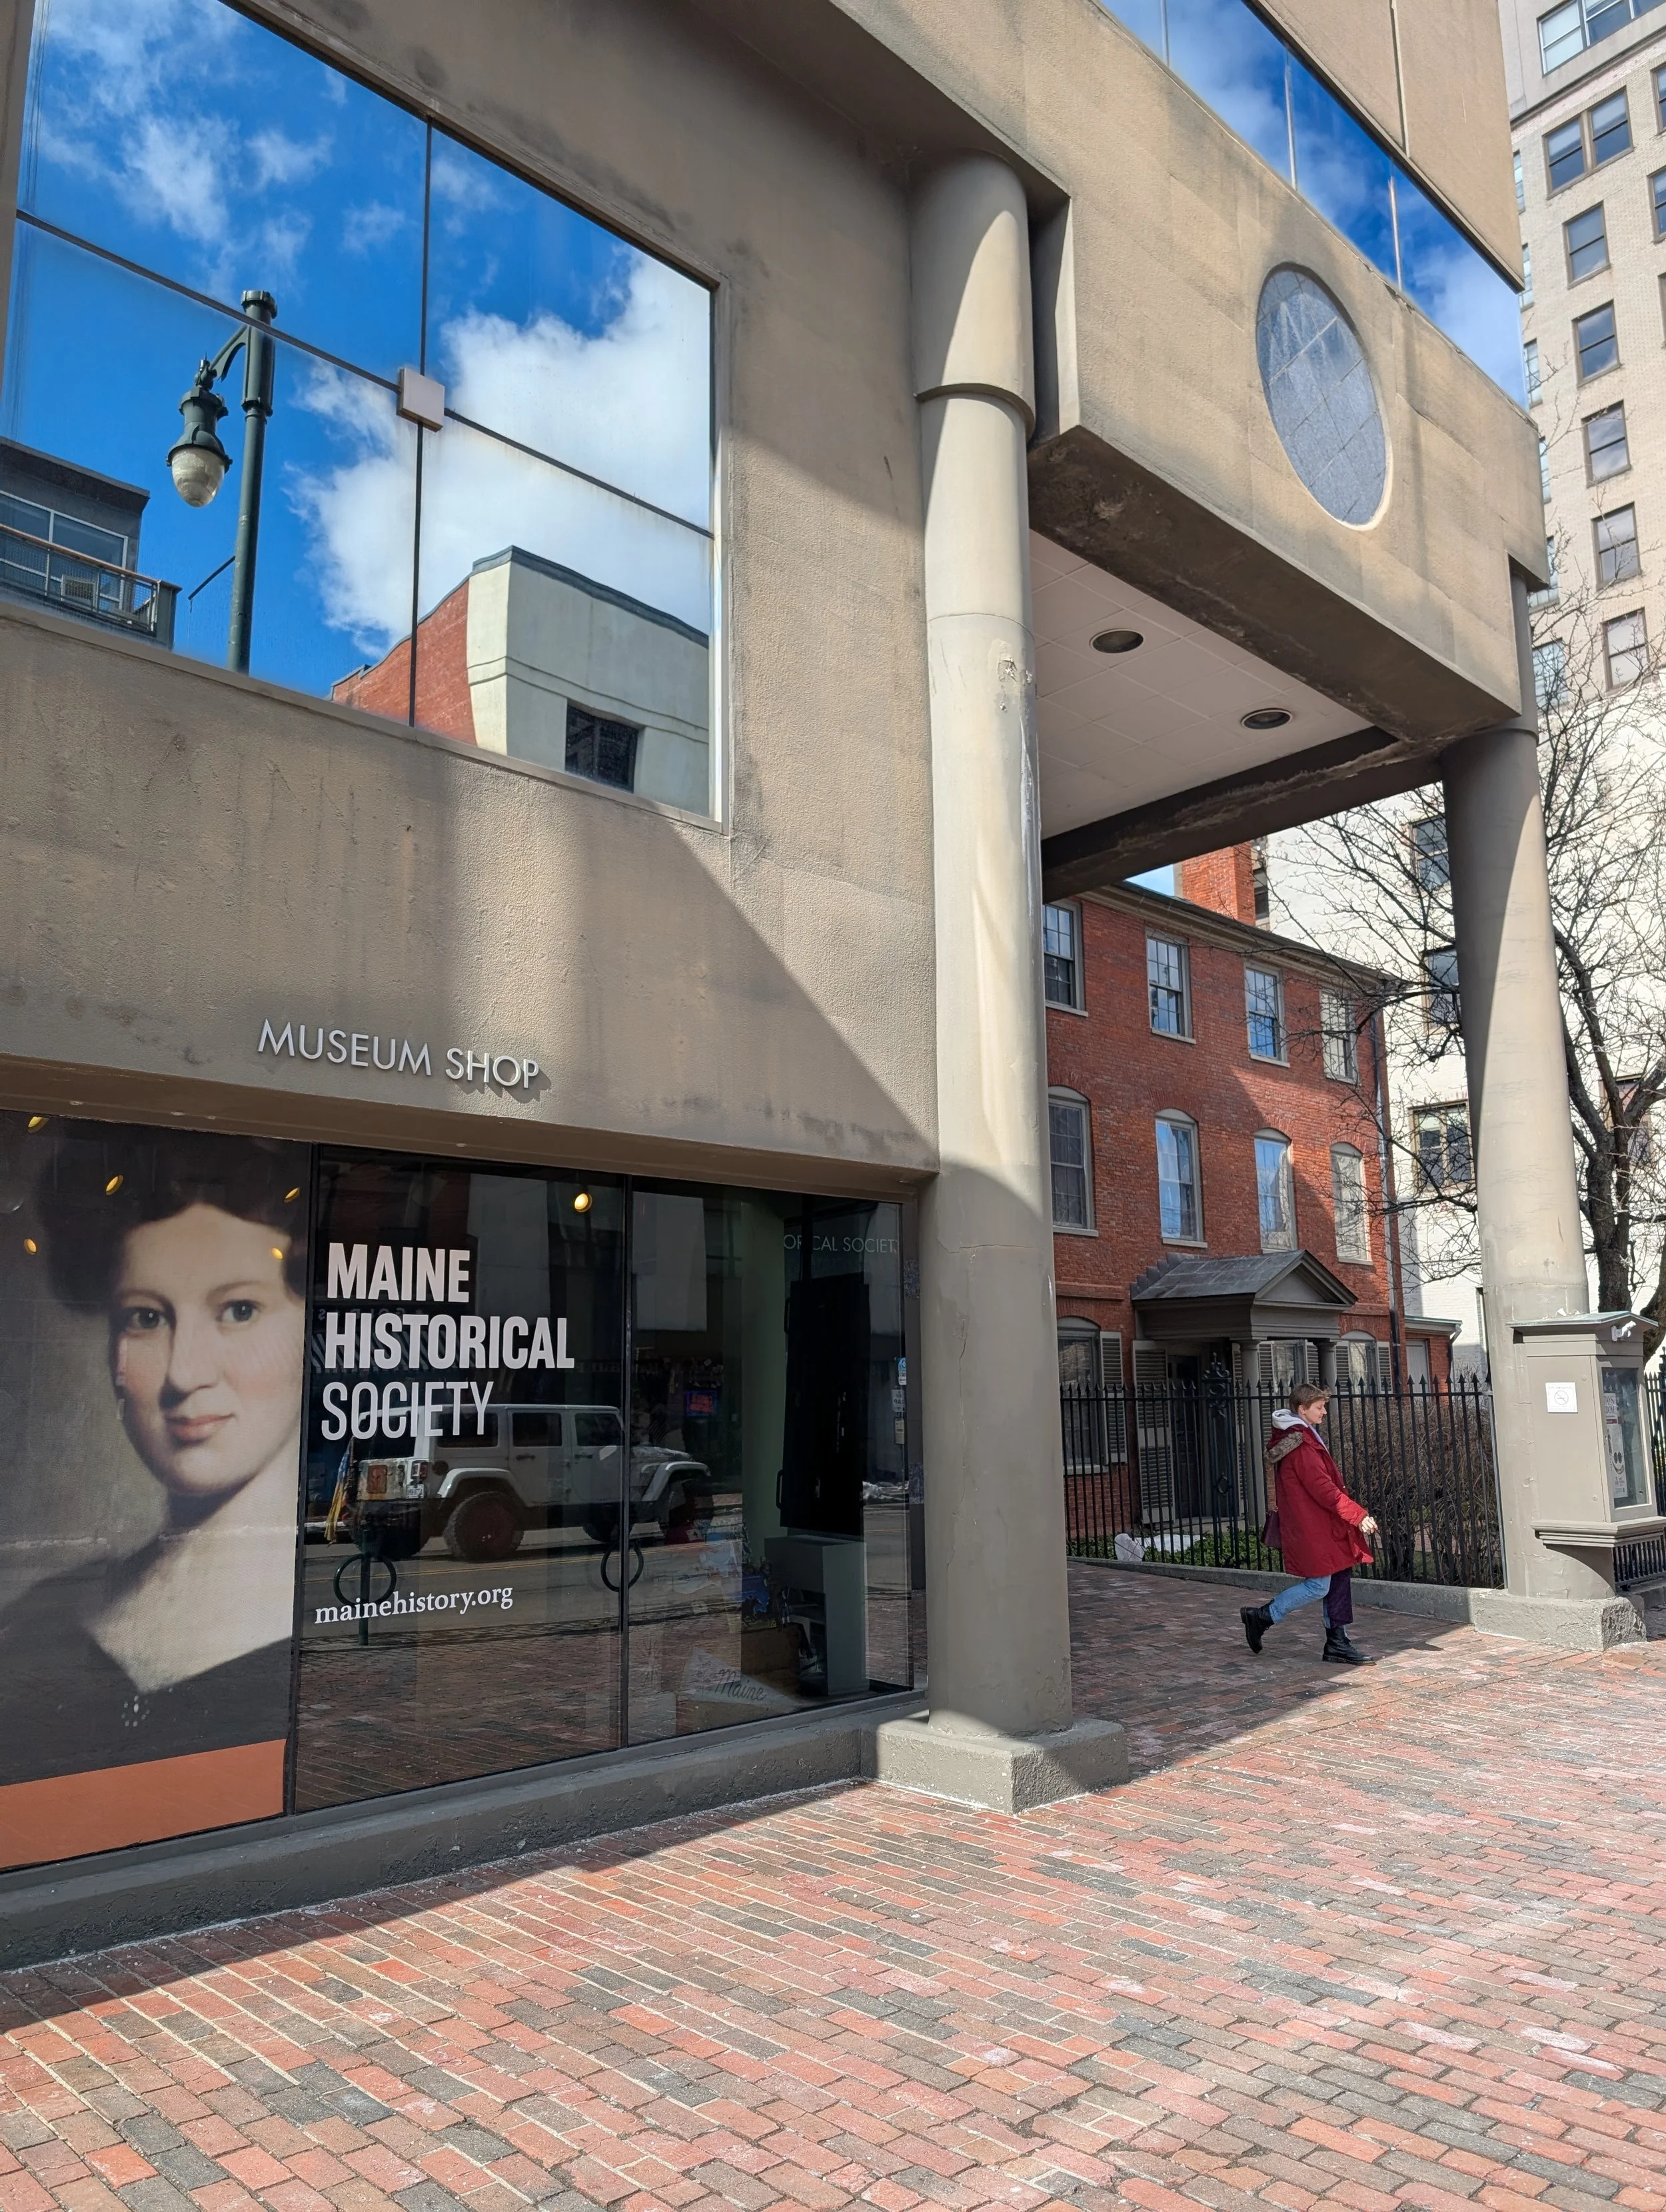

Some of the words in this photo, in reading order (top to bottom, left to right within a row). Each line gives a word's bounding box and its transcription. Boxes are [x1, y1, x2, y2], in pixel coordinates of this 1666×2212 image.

[257, 1018, 432, 1076] MUSEUM
[445, 1047, 539, 1089] SHOP
[327, 1243, 470, 1303] MAINE
[325, 1312, 575, 1369] HISTORICAL
[321, 1381, 494, 1441] SOCIETY
[315, 1587, 513, 1624] mainehistory.org
[714, 1668, 768, 1701] Maine
